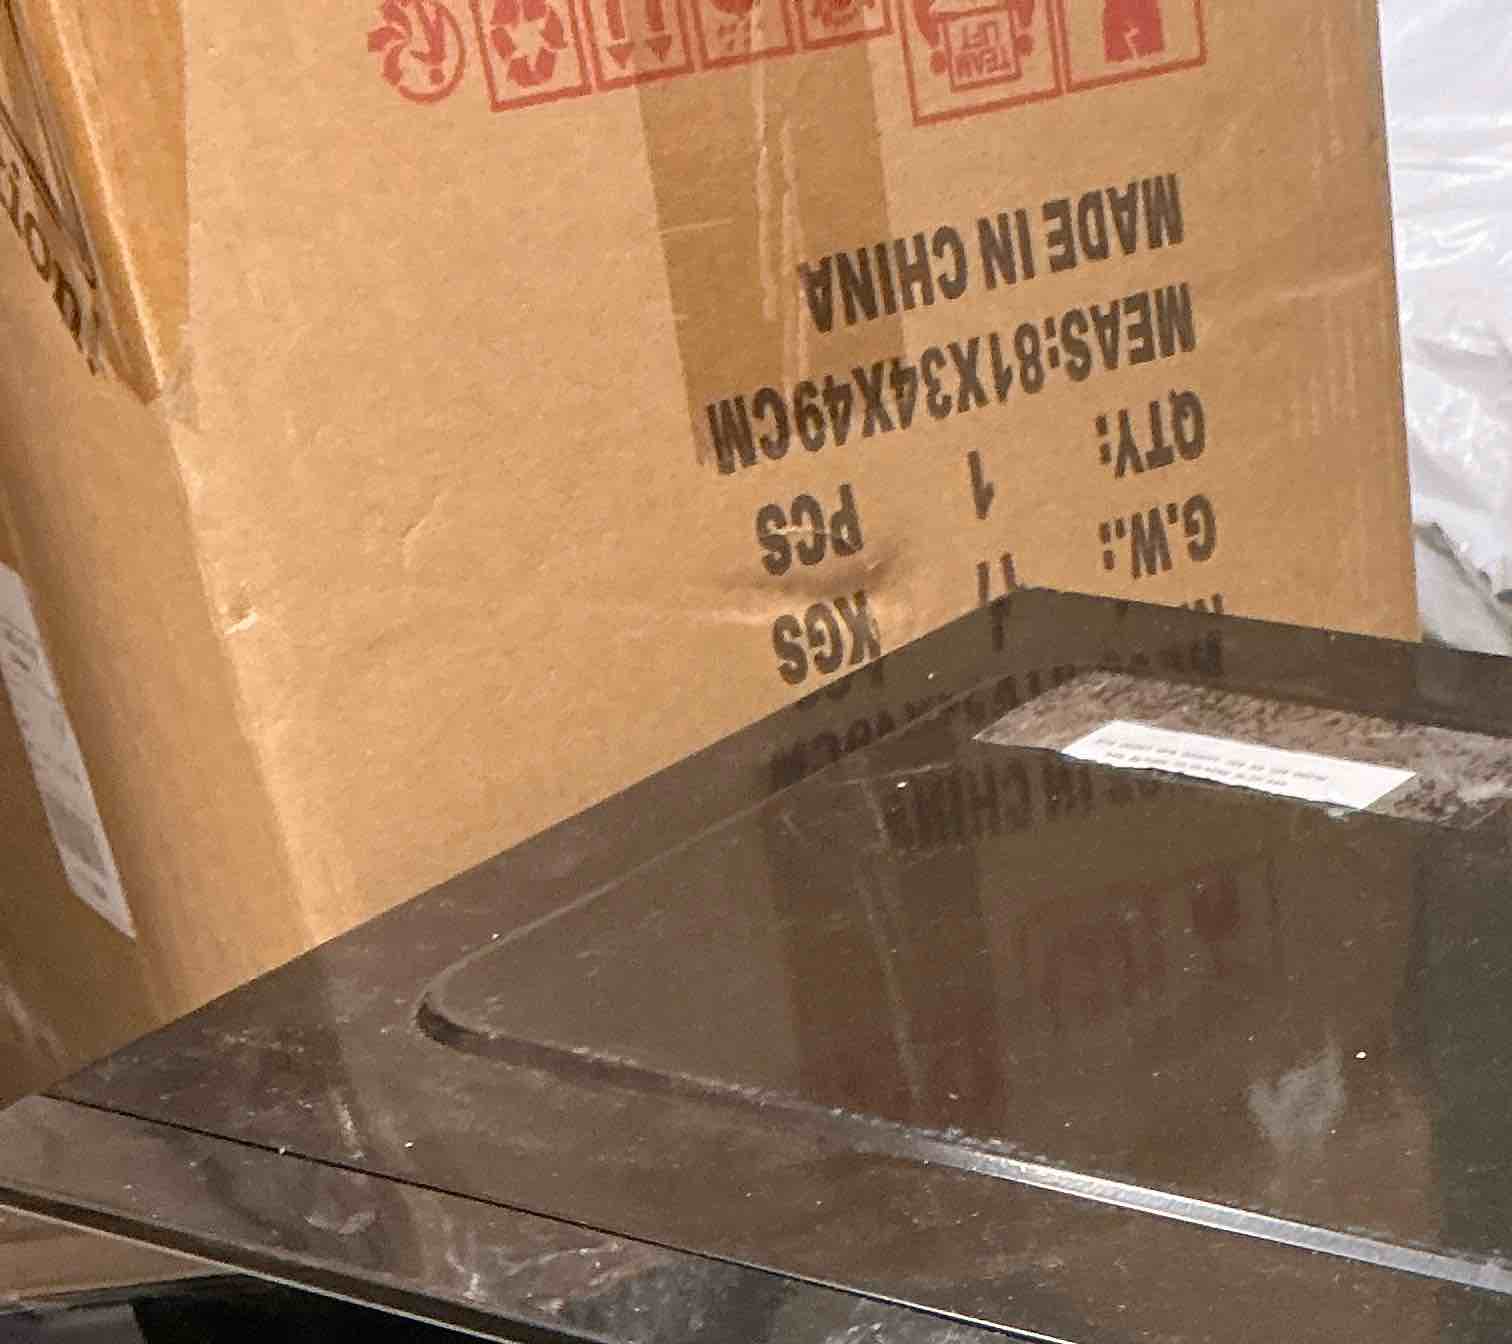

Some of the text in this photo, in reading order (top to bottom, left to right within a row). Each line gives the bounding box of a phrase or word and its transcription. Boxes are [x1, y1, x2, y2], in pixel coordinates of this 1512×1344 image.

[796, 173, 1185, 334] MADE IN CHINA
[755, 389, 1207, 577] QTY: 1 PCS
[770, 591, 883, 685] KGS
